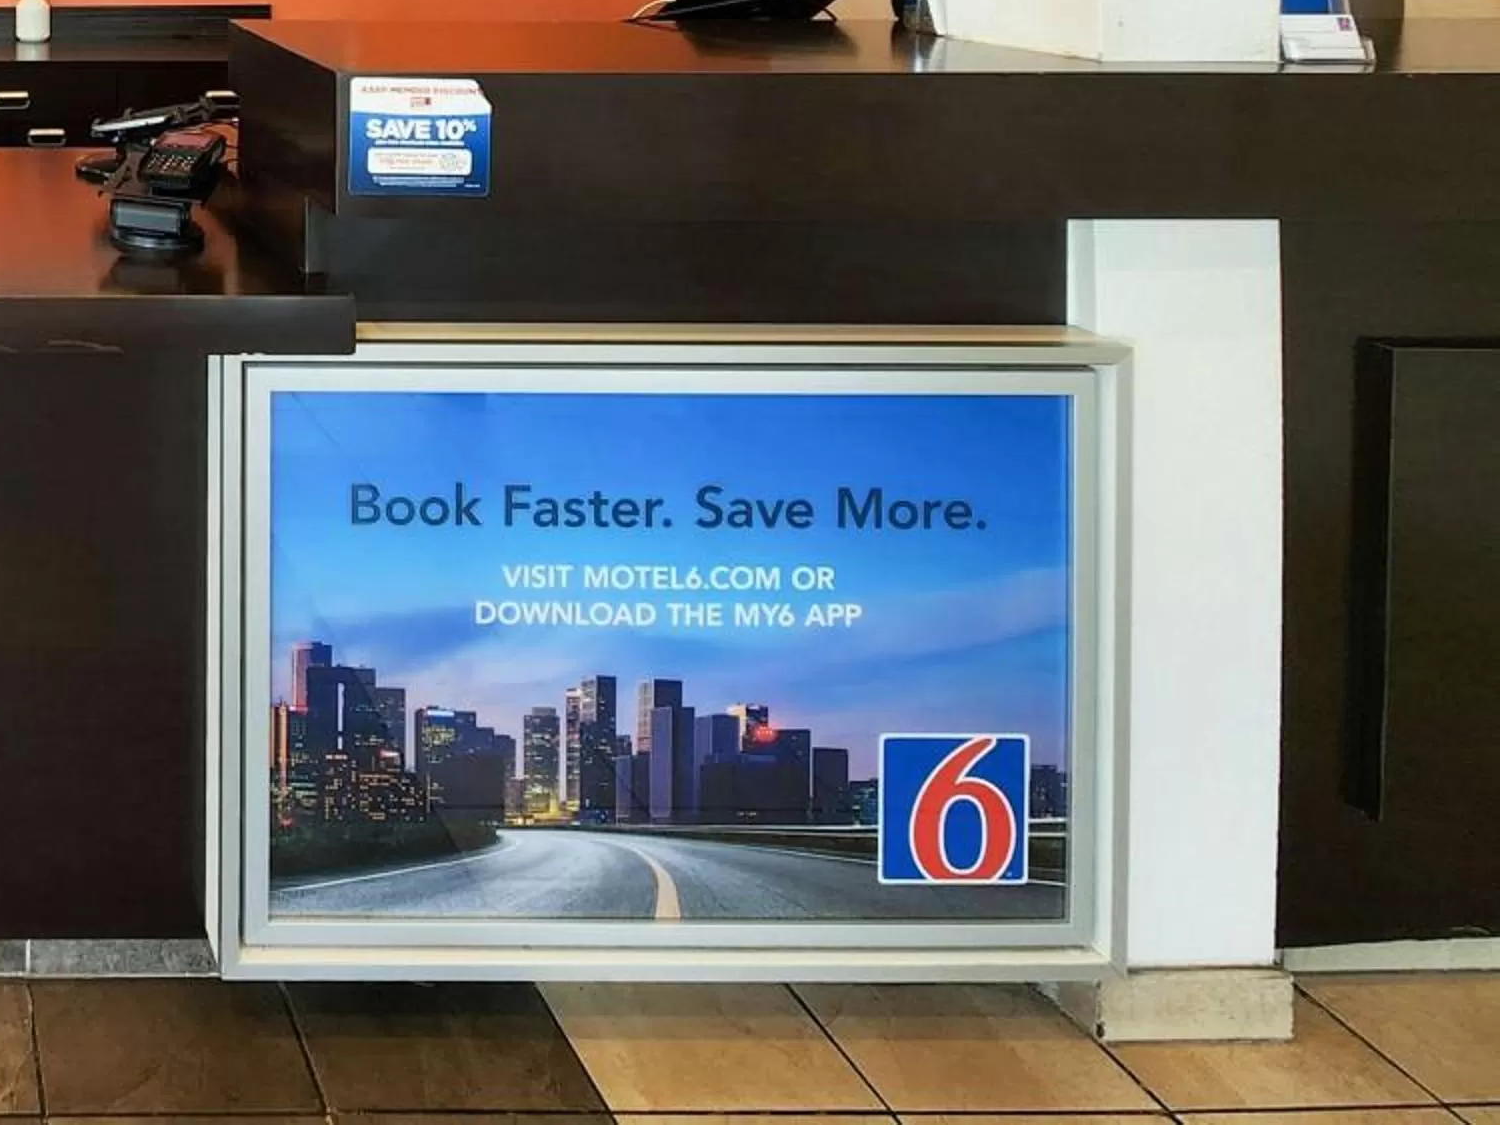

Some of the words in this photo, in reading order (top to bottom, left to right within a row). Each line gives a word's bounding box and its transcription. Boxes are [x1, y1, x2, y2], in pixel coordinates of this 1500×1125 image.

[366, 118, 431, 139] SAVE
[349, 482, 482, 528] Book
[503, 485, 673, 530] Faster.
[695, 485, 816, 531] Save
[838, 487, 988, 532] More.
[502, 565, 572, 590] VISIT
[583, 565, 782, 592] MOTEL6.COM
[792, 566, 836, 591] OR
[474, 602, 657, 627] DOWNLOAD
[667, 602, 724, 627] THE
[734, 603, 796, 628] MY6
[805, 603, 864, 629] APP
[908, 734, 1017, 884] 6
